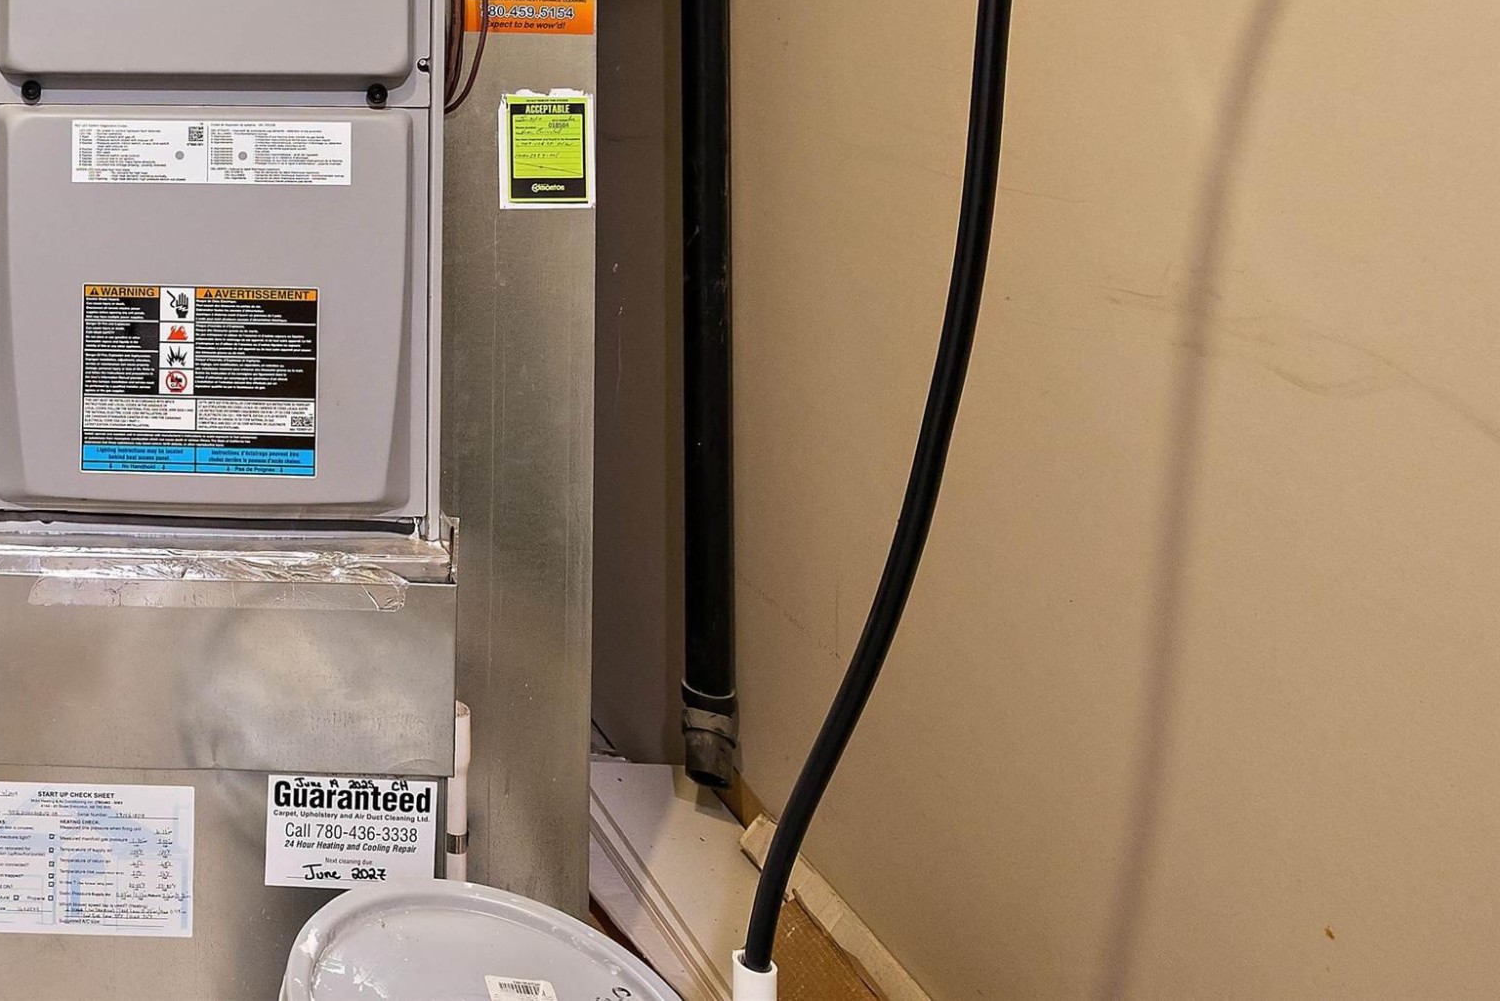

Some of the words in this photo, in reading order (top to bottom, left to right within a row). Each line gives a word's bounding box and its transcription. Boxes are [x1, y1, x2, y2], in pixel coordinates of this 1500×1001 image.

[481, 5, 574, 18] 80.459.5154
[525, 105, 570, 114] ACCEPTABLE
[101, 287, 155, 297] WARNING
[214, 289, 310, 301] AVERTISSEMENT
[295, 778, 322, 788] June
[391, 781, 409, 792] CH
[274, 780, 432, 813] Guaranteed
[273, 809, 299, 818] Carpet,
[300, 810, 338, 820] Upholstery
[384, 814, 415, 823] Cleaning
[285, 822, 311, 838] Call
[316, 824, 418, 843] 780-436-3338
[284, 840, 295, 848] 24
[296, 841, 315, 849] Hour
[316, 841, 345, 852] Heating
[362, 843, 391, 853] Cooling
[392, 845, 417, 854] Repair
[338, 858, 361, 866] cleaning
[302, 864, 341, 881] June
